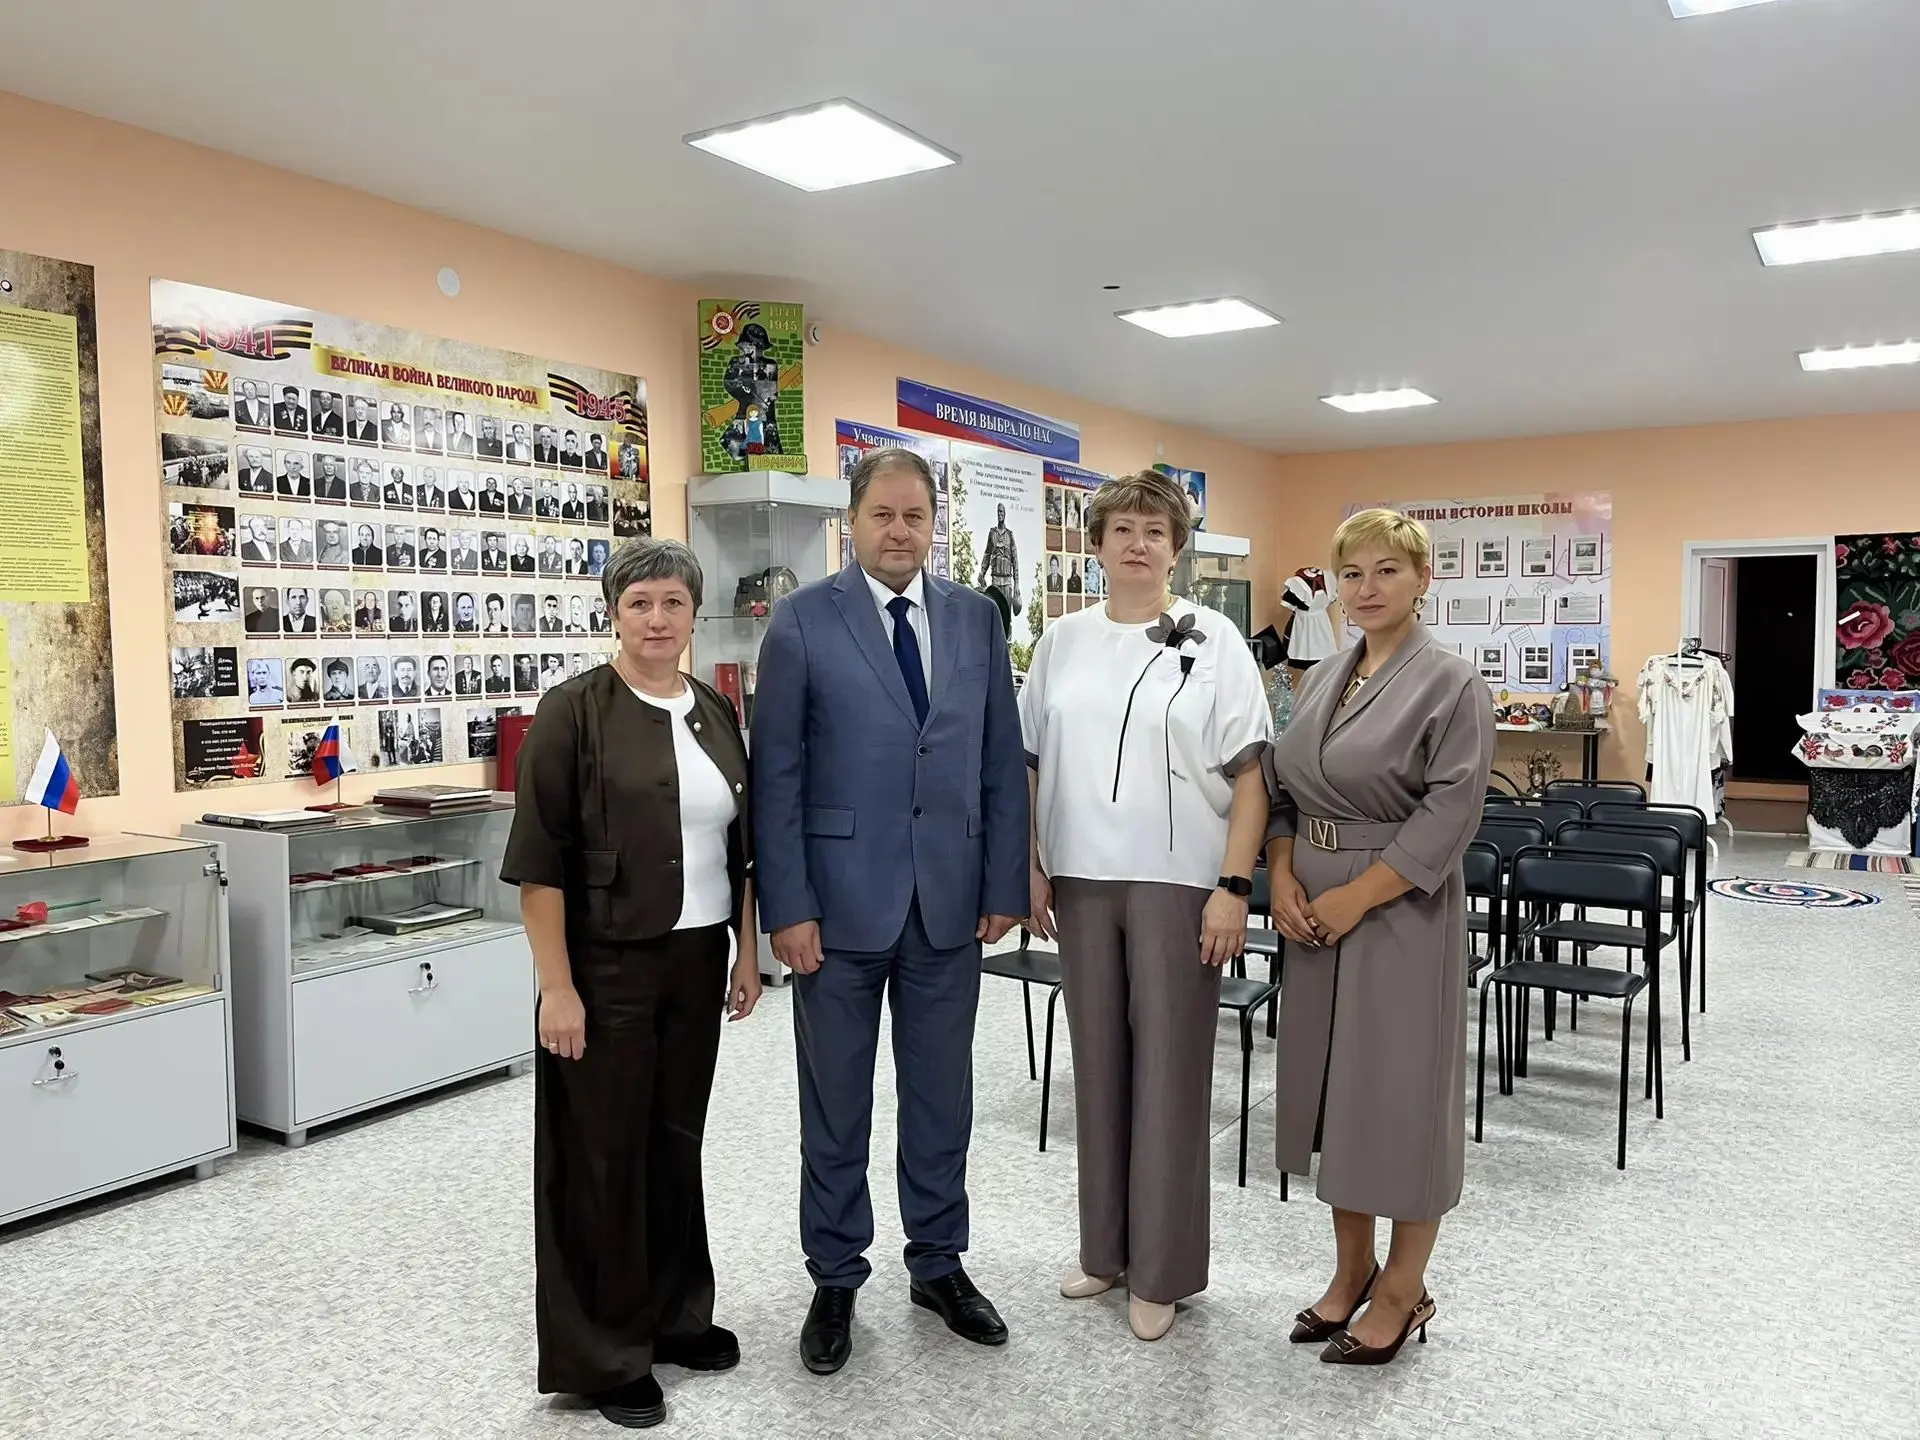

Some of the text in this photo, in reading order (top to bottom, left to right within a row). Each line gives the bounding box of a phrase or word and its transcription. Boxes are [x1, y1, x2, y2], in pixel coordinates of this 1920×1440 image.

[769, 319, 798, 331] 1945
[198, 321, 275, 359] 1941
[331, 355, 538, 405] ВЕЛИКАЯ ВОЙНА ВЕЛИКОГО НАРОДА
[576, 391, 627, 422] 1945
[936, 402, 1054, 444] ВРЕМЯ ВЫБРАЛО НАС
[853, 427, 911, 449] Участники
[750, 455, 805, 469] ПОМНИМ
[1450, 504, 1514, 519] ИСТОРИИ
[1518, 502, 1573, 516] ШКОЛЫ
